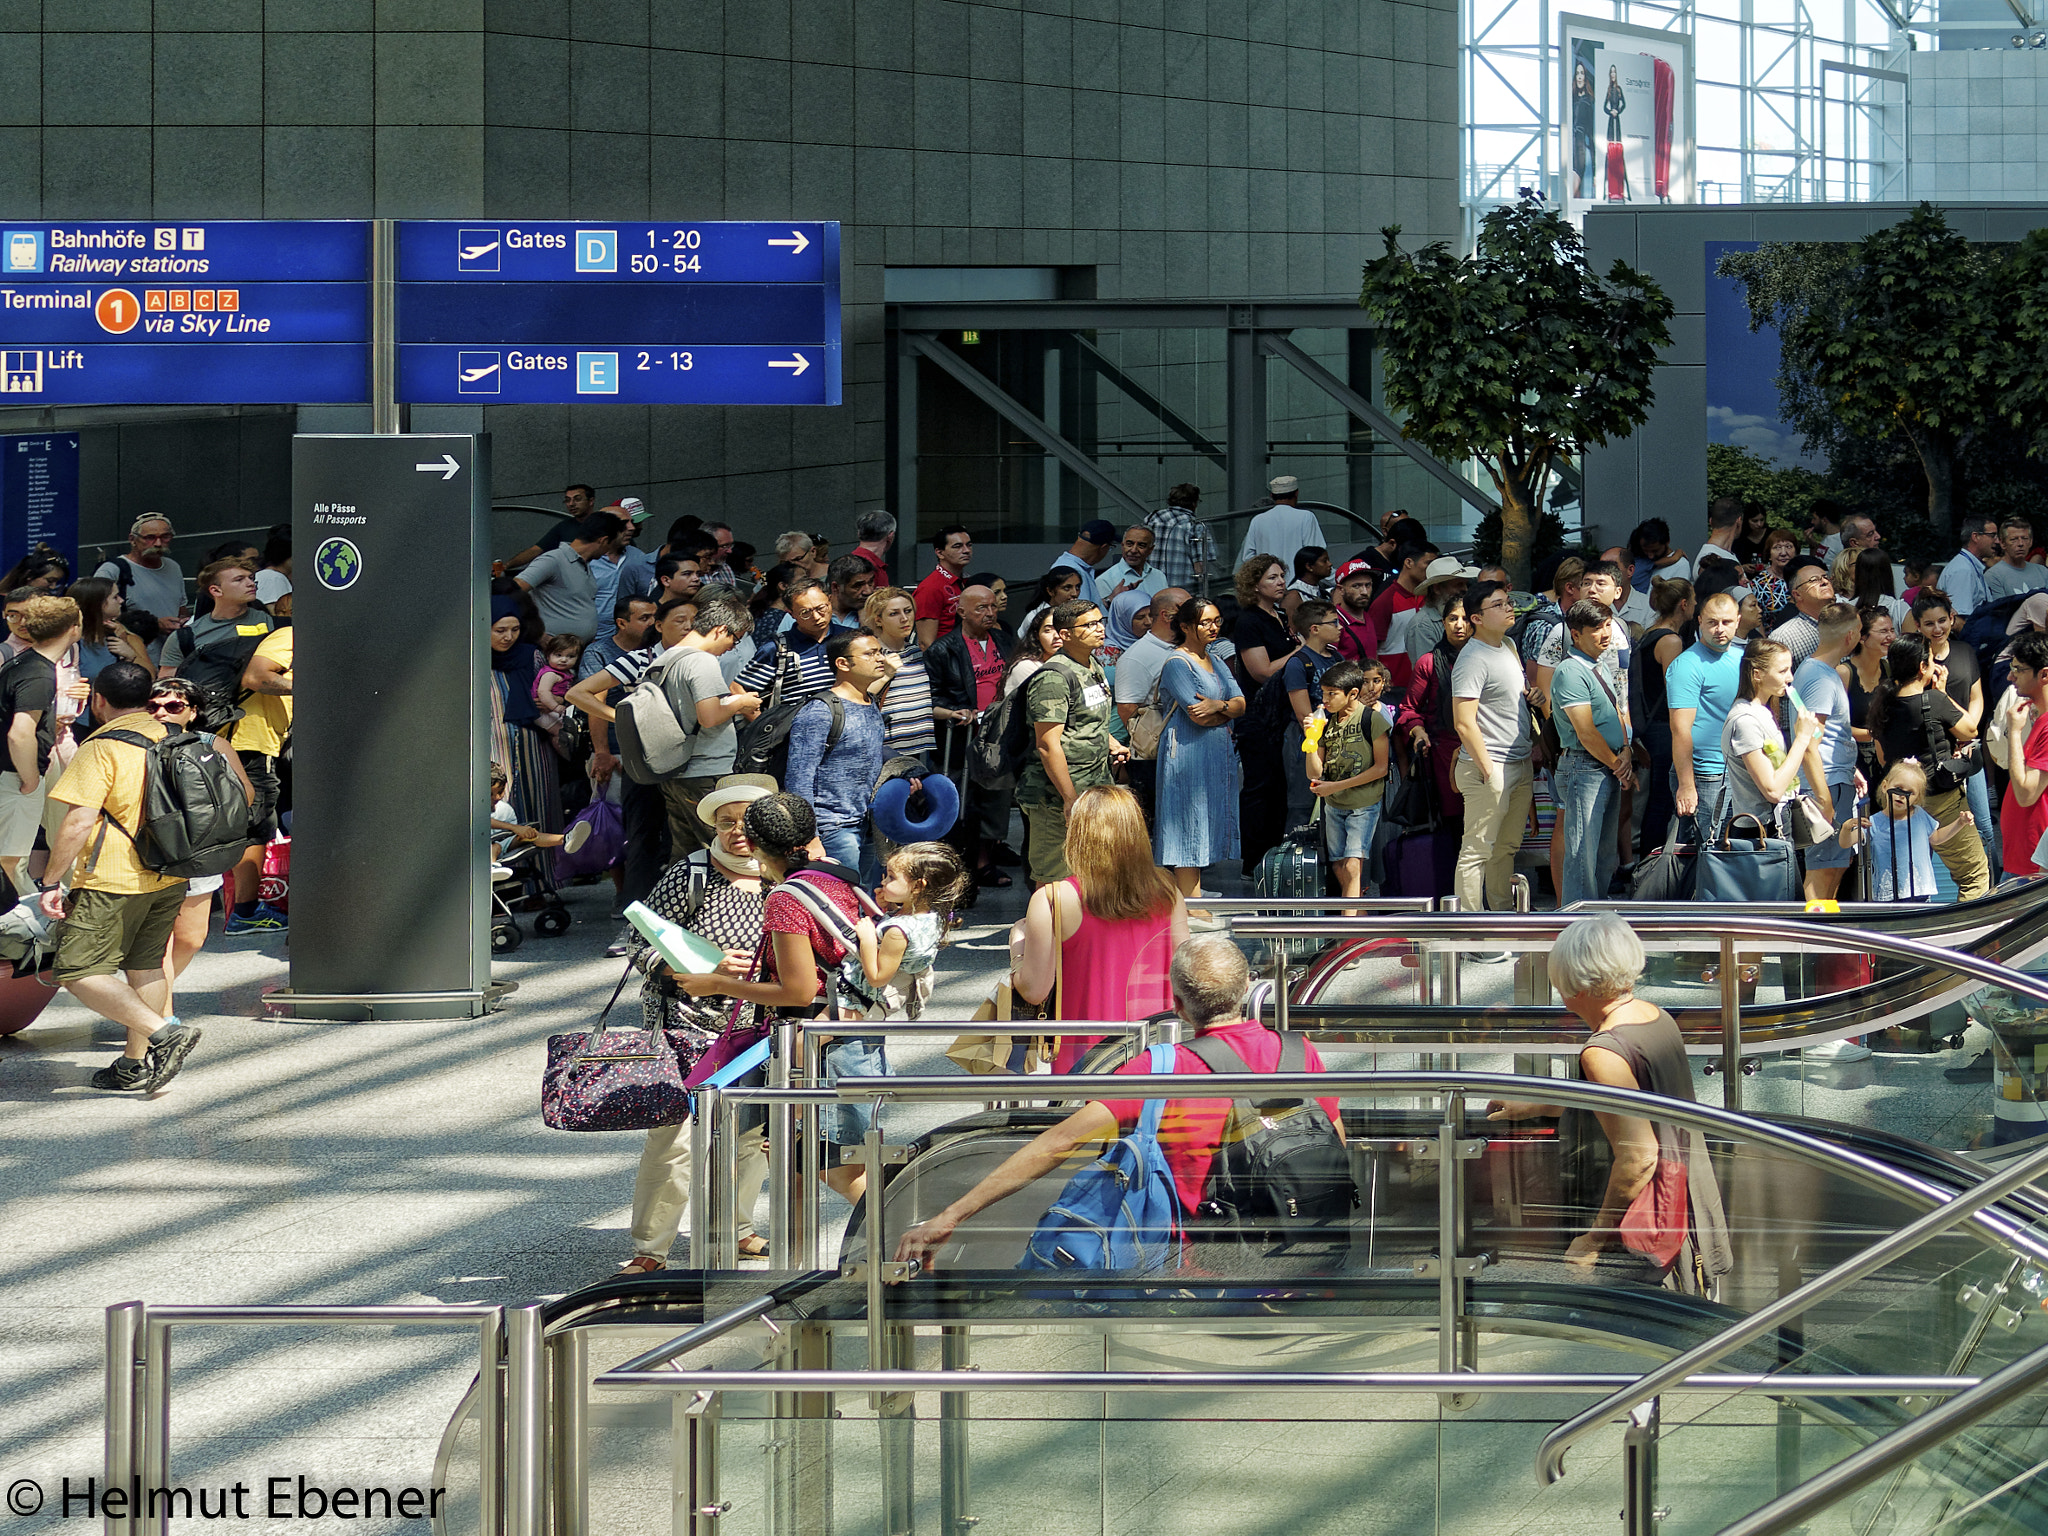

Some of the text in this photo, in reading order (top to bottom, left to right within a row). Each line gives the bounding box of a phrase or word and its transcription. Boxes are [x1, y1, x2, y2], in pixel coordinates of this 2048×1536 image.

[50, 229, 199, 249] Bahnhöfe S T
[505, 229, 567, 249] Gates
[586, 239, 607, 263] D
[49, 254, 210, 276] Railway stations
[0, 289, 233, 323] Terminal 1 A B C Z
[144, 313, 271, 337] via Sky Line
[48, 350, 84, 369] Lift
[507, 351, 568, 370] Gates
[589, 361, 605, 385] E
[45, 440, 51, 450] E
[313, 503, 356, 513] Alle Pässe
[313, 514, 367, 526] All Passports
